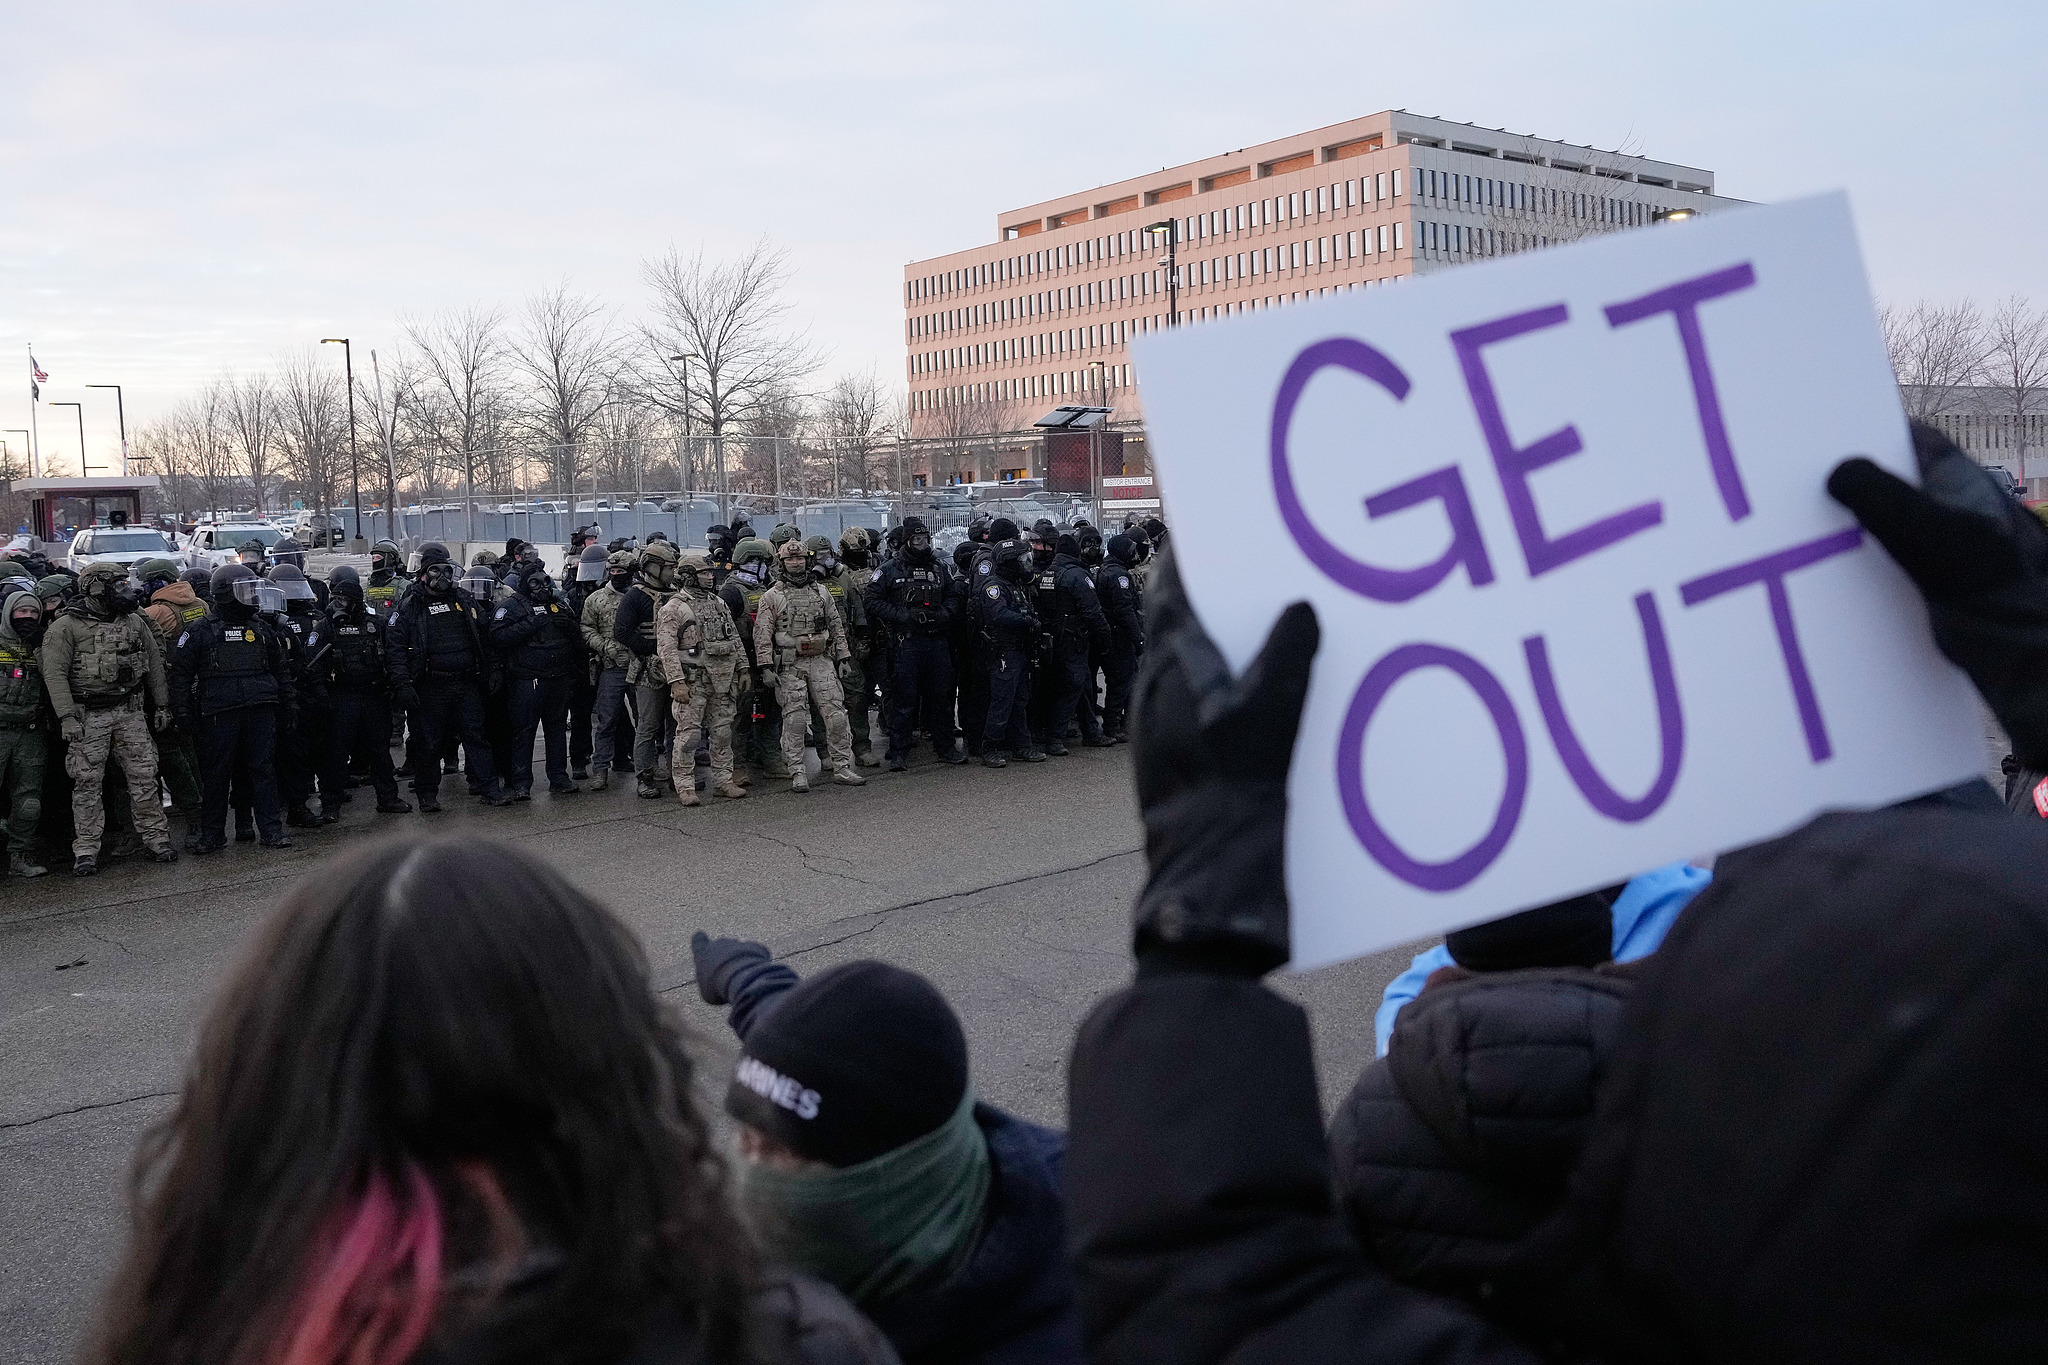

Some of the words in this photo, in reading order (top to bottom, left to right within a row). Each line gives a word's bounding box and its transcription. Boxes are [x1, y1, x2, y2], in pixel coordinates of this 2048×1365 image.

[1268, 262, 1758, 604] GET
[1105, 478, 1123, 486] VISITOR
[1124, 477, 1151, 485] ENTRANCE
[1113, 487, 1143, 498] NOTICE
[1002, 541, 1014, 549] POLICE
[1041, 576, 1055, 584] POLICE
[428, 603, 449, 612] POLICE
[1336, 526, 1864, 894] OUT
